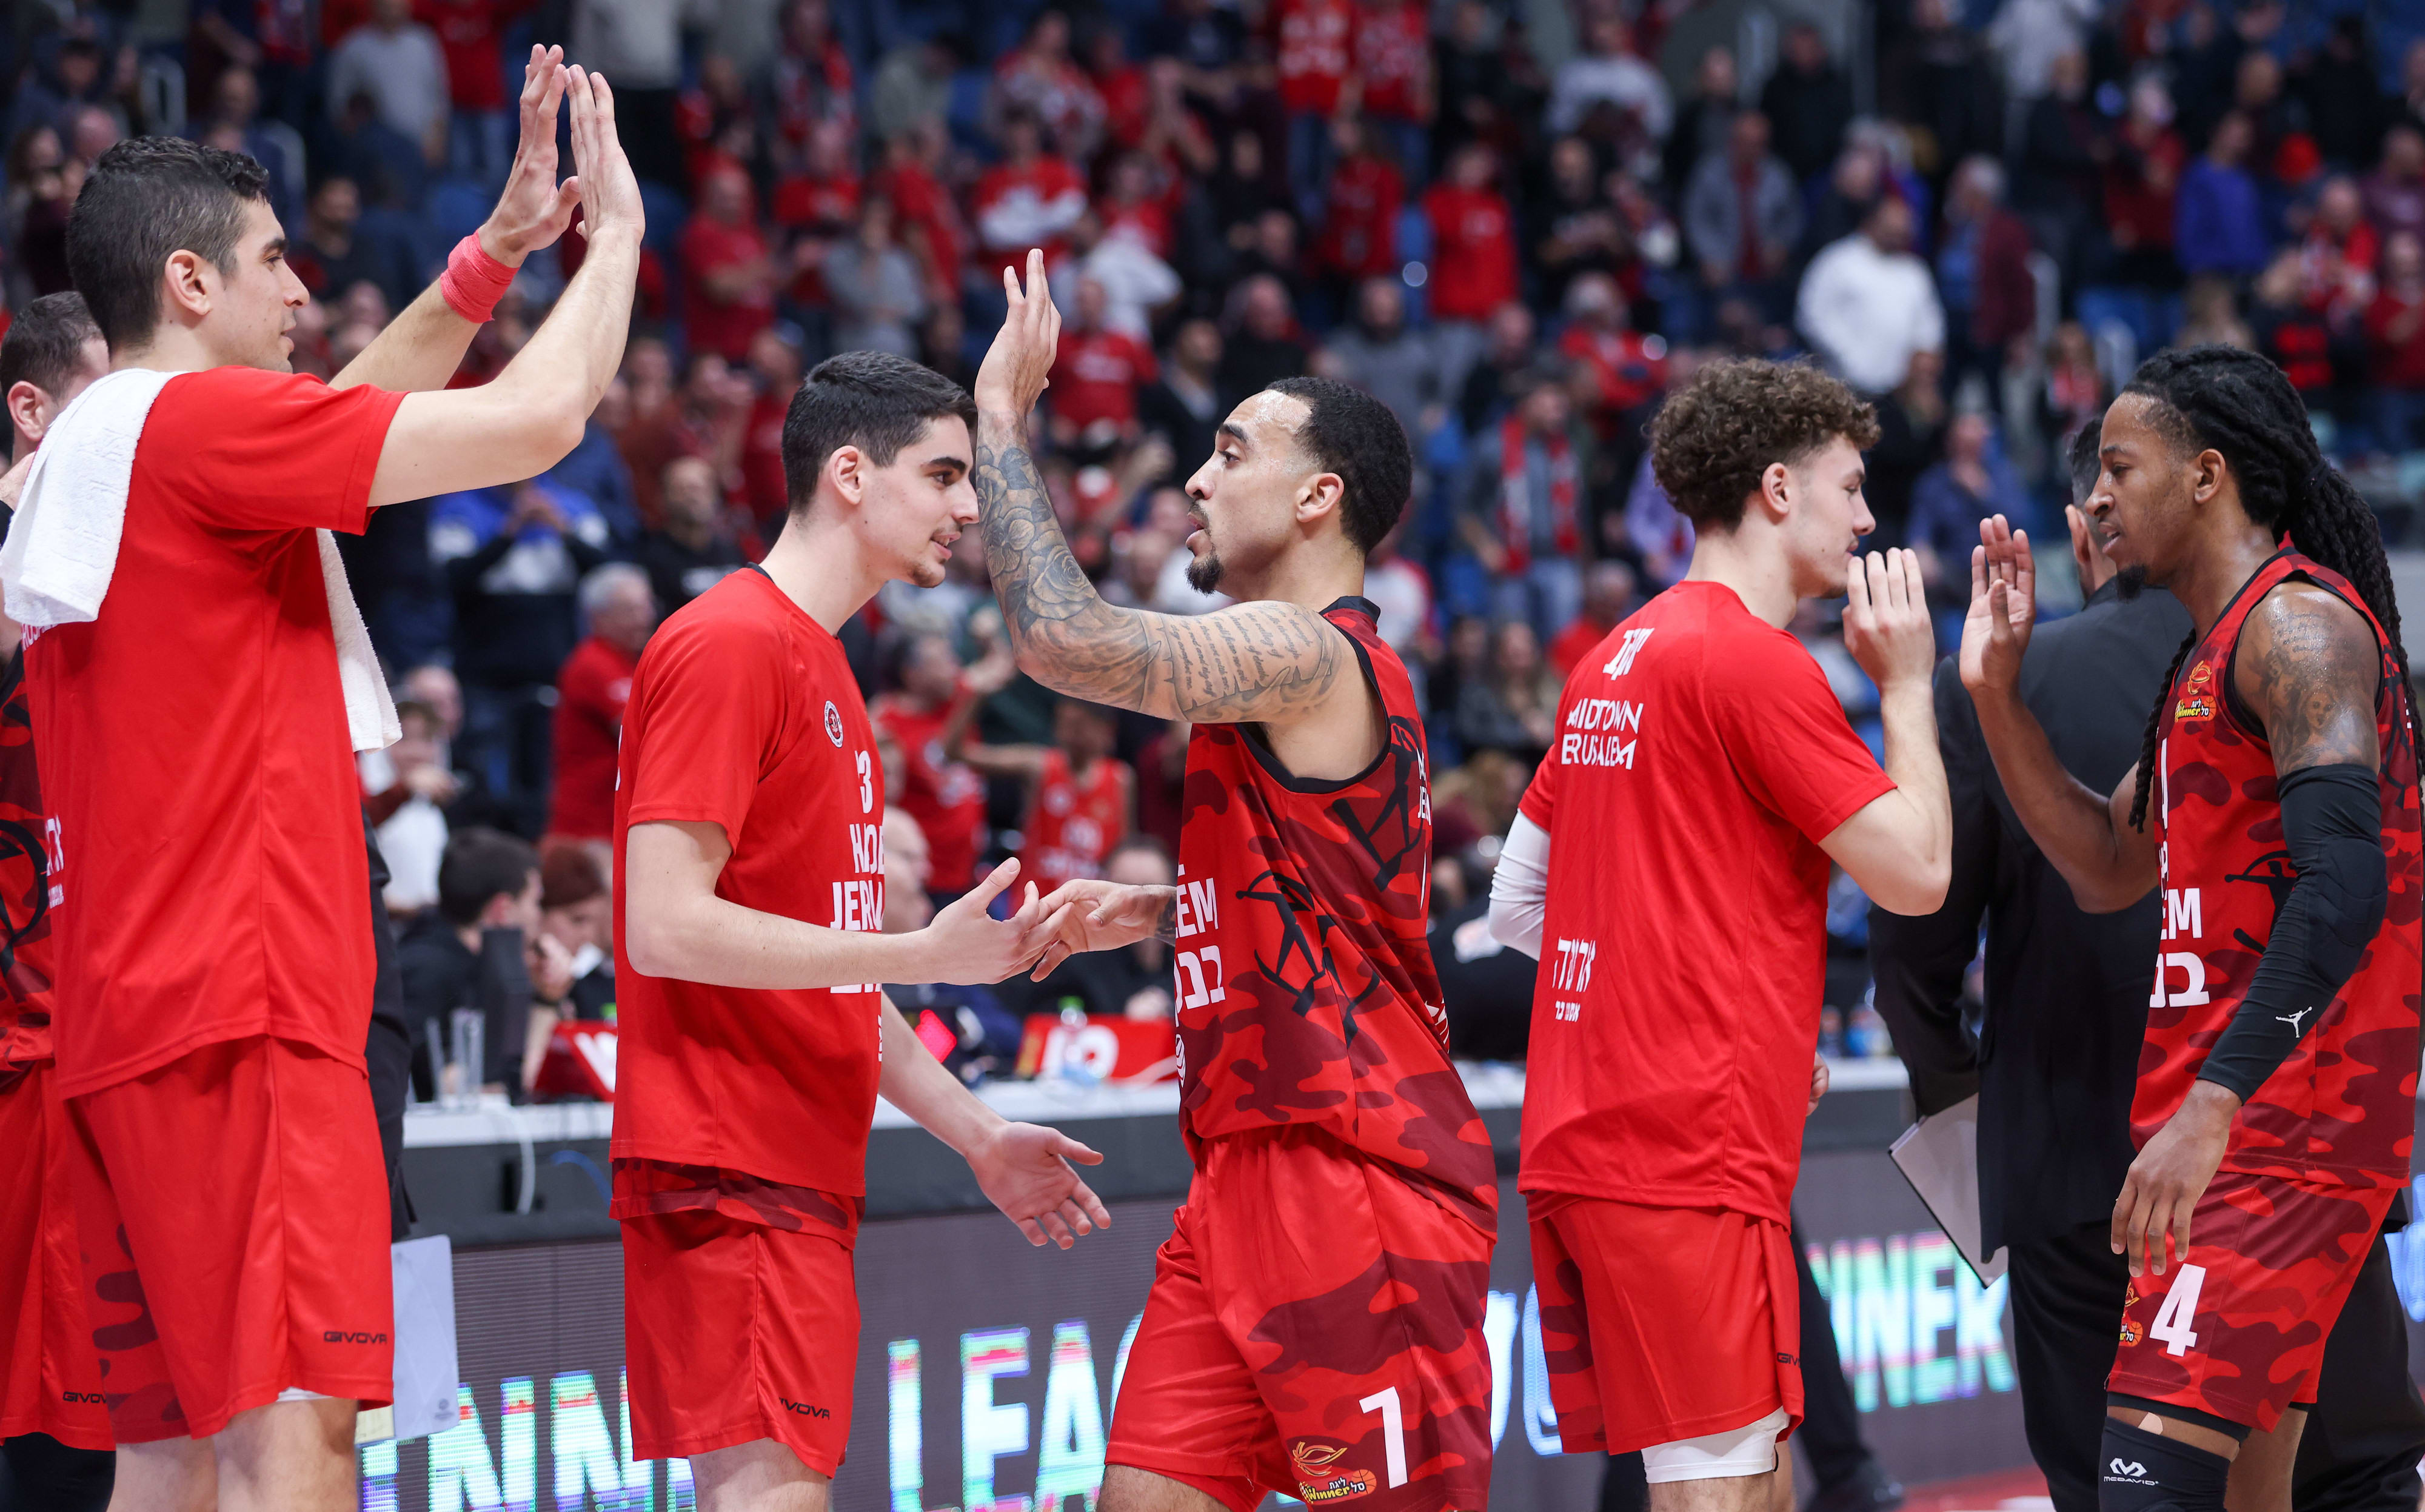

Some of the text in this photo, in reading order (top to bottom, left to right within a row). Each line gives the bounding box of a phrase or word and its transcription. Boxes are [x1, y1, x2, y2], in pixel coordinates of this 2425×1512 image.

[2149, 1263, 2206, 1357] 4
[1359, 1386, 1408, 1489] 7
[1351, 1481, 1365, 1493] סל
